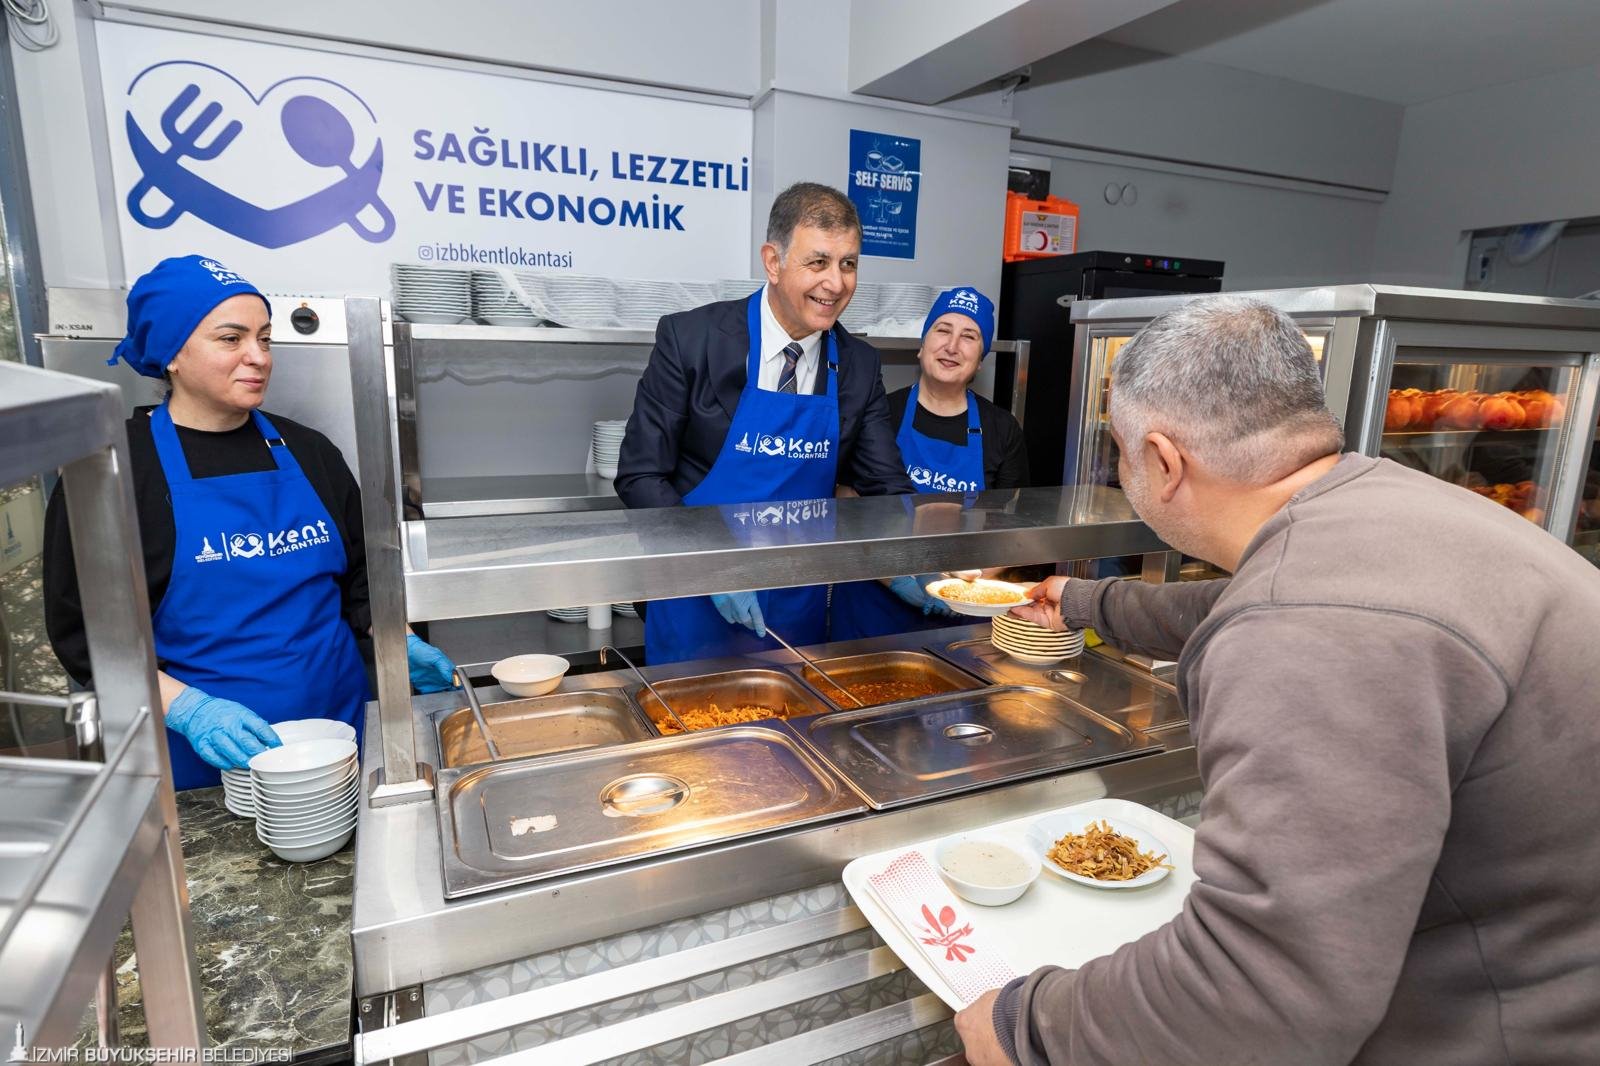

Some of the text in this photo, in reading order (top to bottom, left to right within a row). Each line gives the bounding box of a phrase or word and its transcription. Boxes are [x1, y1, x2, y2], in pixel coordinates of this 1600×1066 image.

[413, 126, 749, 191] SAĞLIKLI, LEZZETLİ
[855, 170, 913, 192] SELF SERVİS
[414, 181, 686, 231] VE EKONOMİK
[949, 298, 979, 311] Kent
[787, 451, 828, 459] LOKANTASI
[788, 437, 830, 452] Kent
[933, 472, 977, 491] Kent
[268, 519, 329, 549] Kent
[269, 535, 330, 557] LOKANTASI
